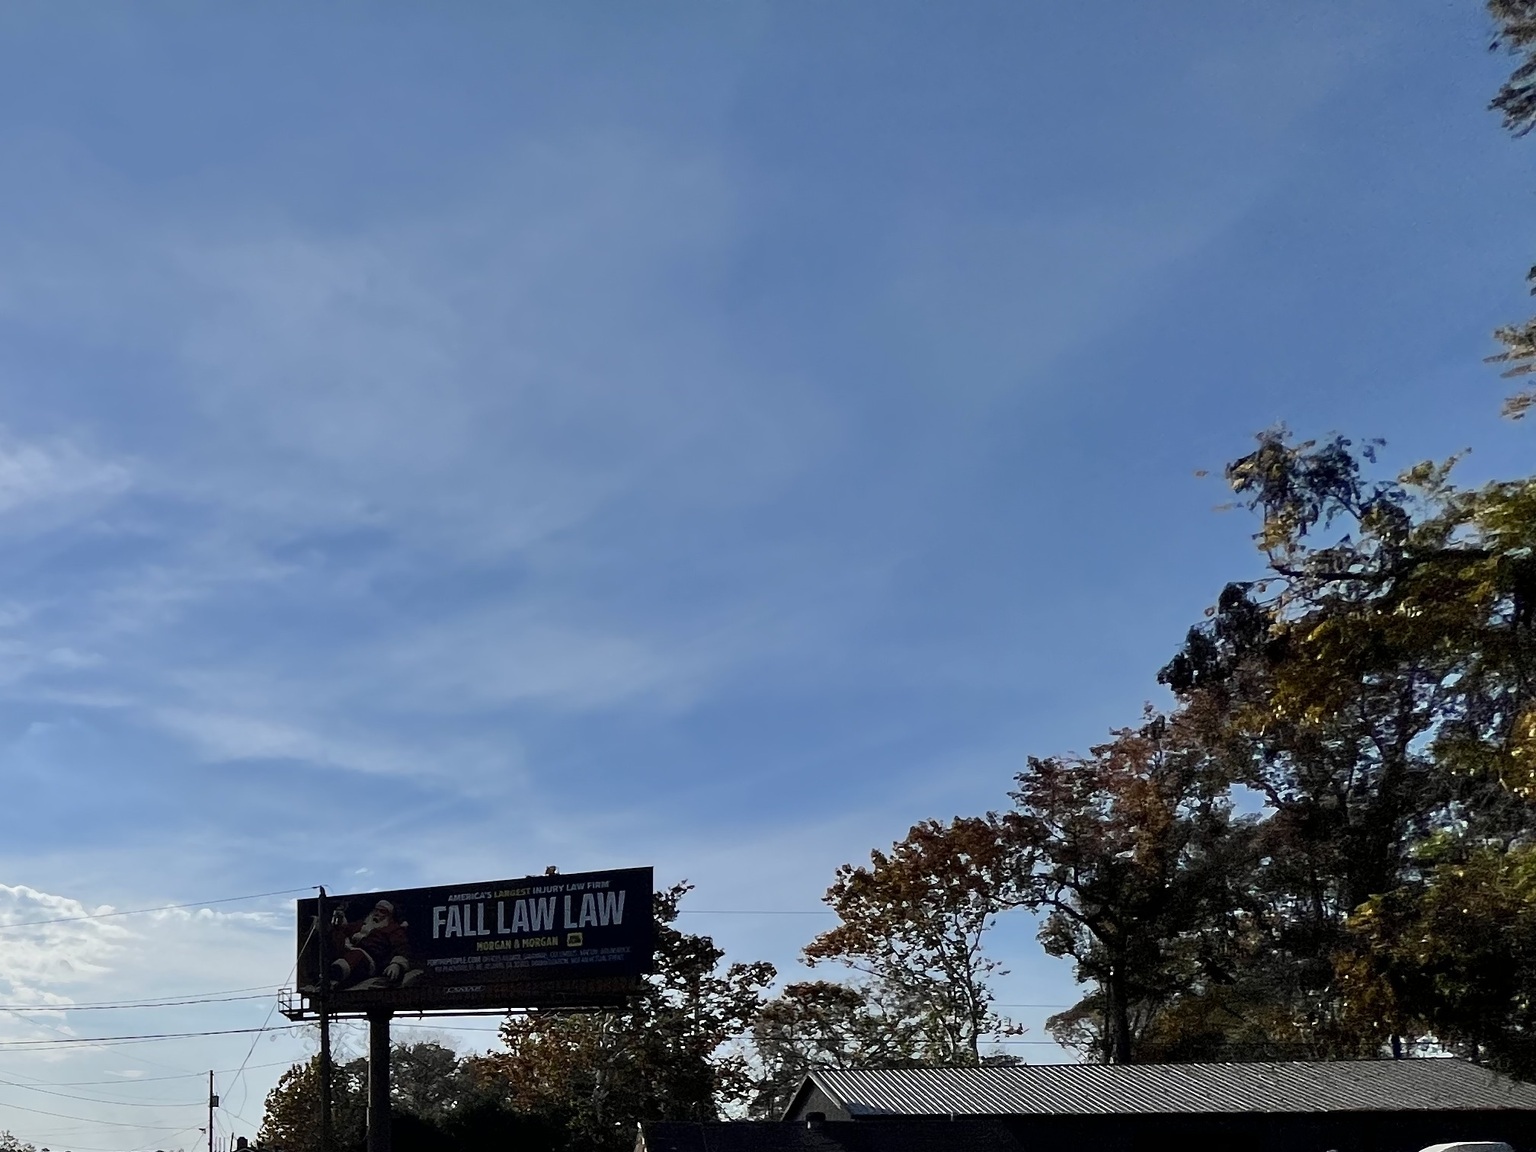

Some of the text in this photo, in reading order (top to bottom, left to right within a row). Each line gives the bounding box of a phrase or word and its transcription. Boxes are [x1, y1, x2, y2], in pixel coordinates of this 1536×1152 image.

[448, 881, 610, 901] AMERICA'S LARGEST INJURY LAW FIRM
[433, 890, 626, 939] FALL LAW LAW
[476, 940, 511, 951] MORGAN
[514, 939, 520, 949] &
[522, 936, 558, 947] MORGAN
